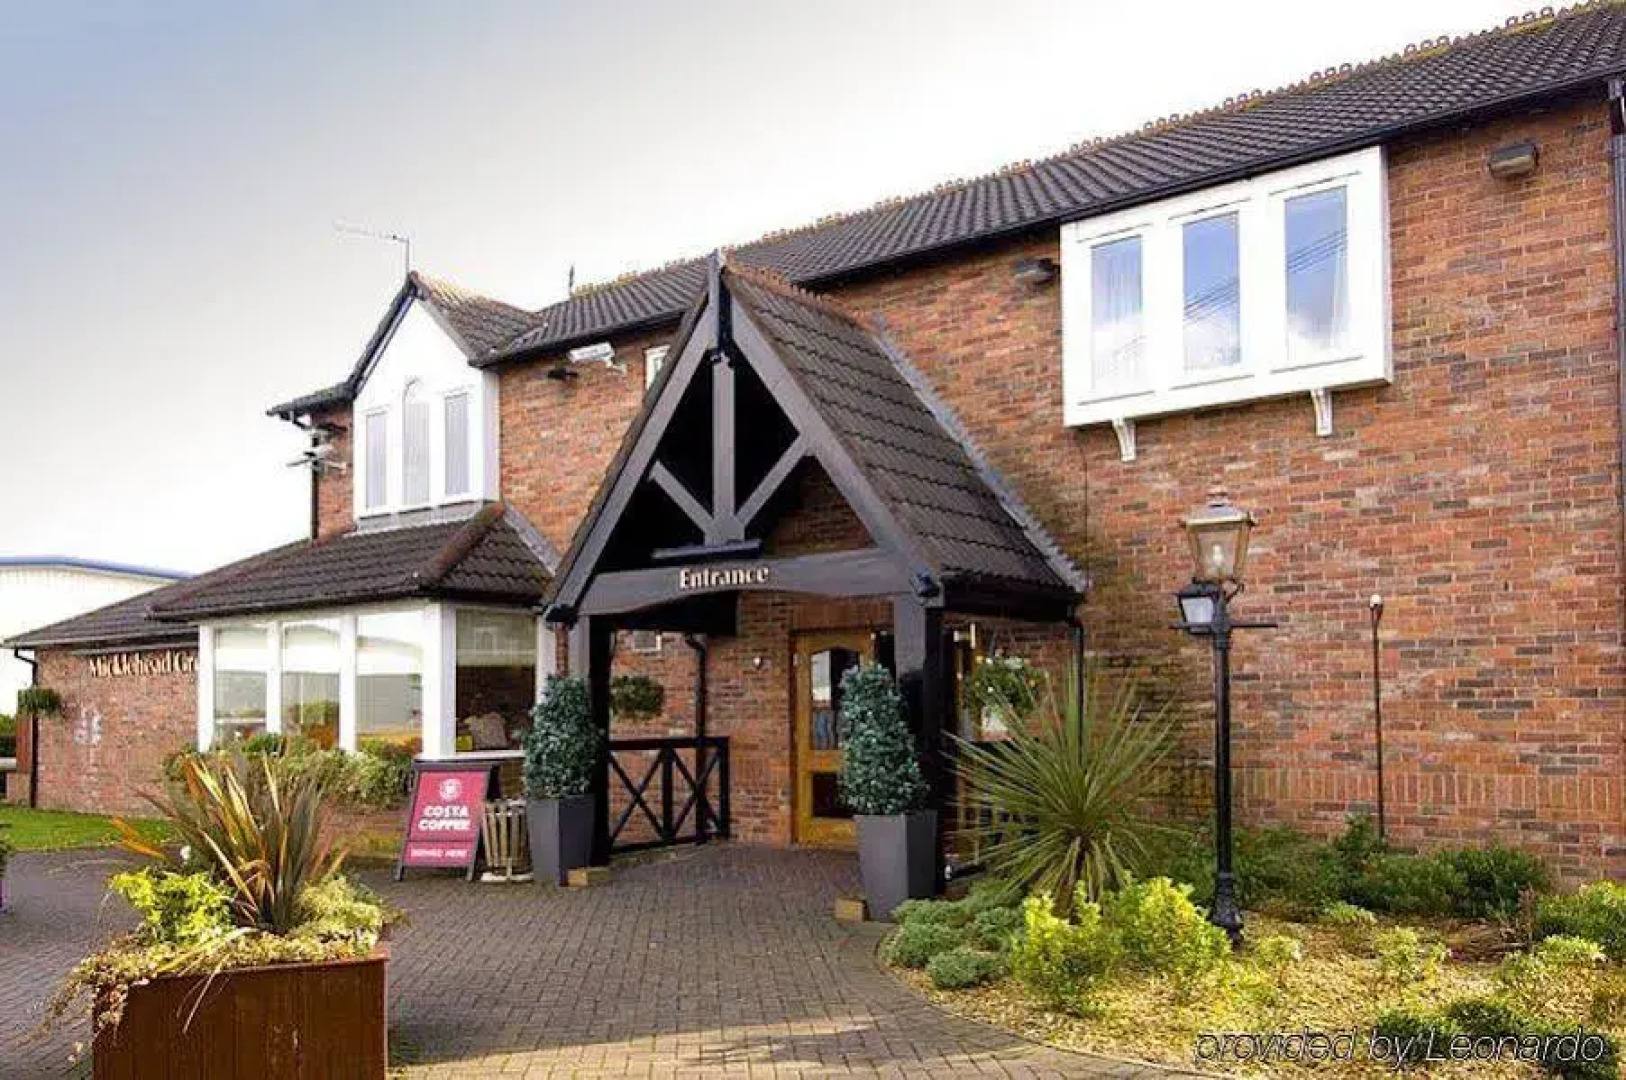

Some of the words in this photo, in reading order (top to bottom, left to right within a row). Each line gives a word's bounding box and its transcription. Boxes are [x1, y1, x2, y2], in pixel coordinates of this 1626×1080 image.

[680, 567, 768, 588] Entrance
[424, 805, 470, 818] COSTA
[418, 819, 472, 832] COFFEE
